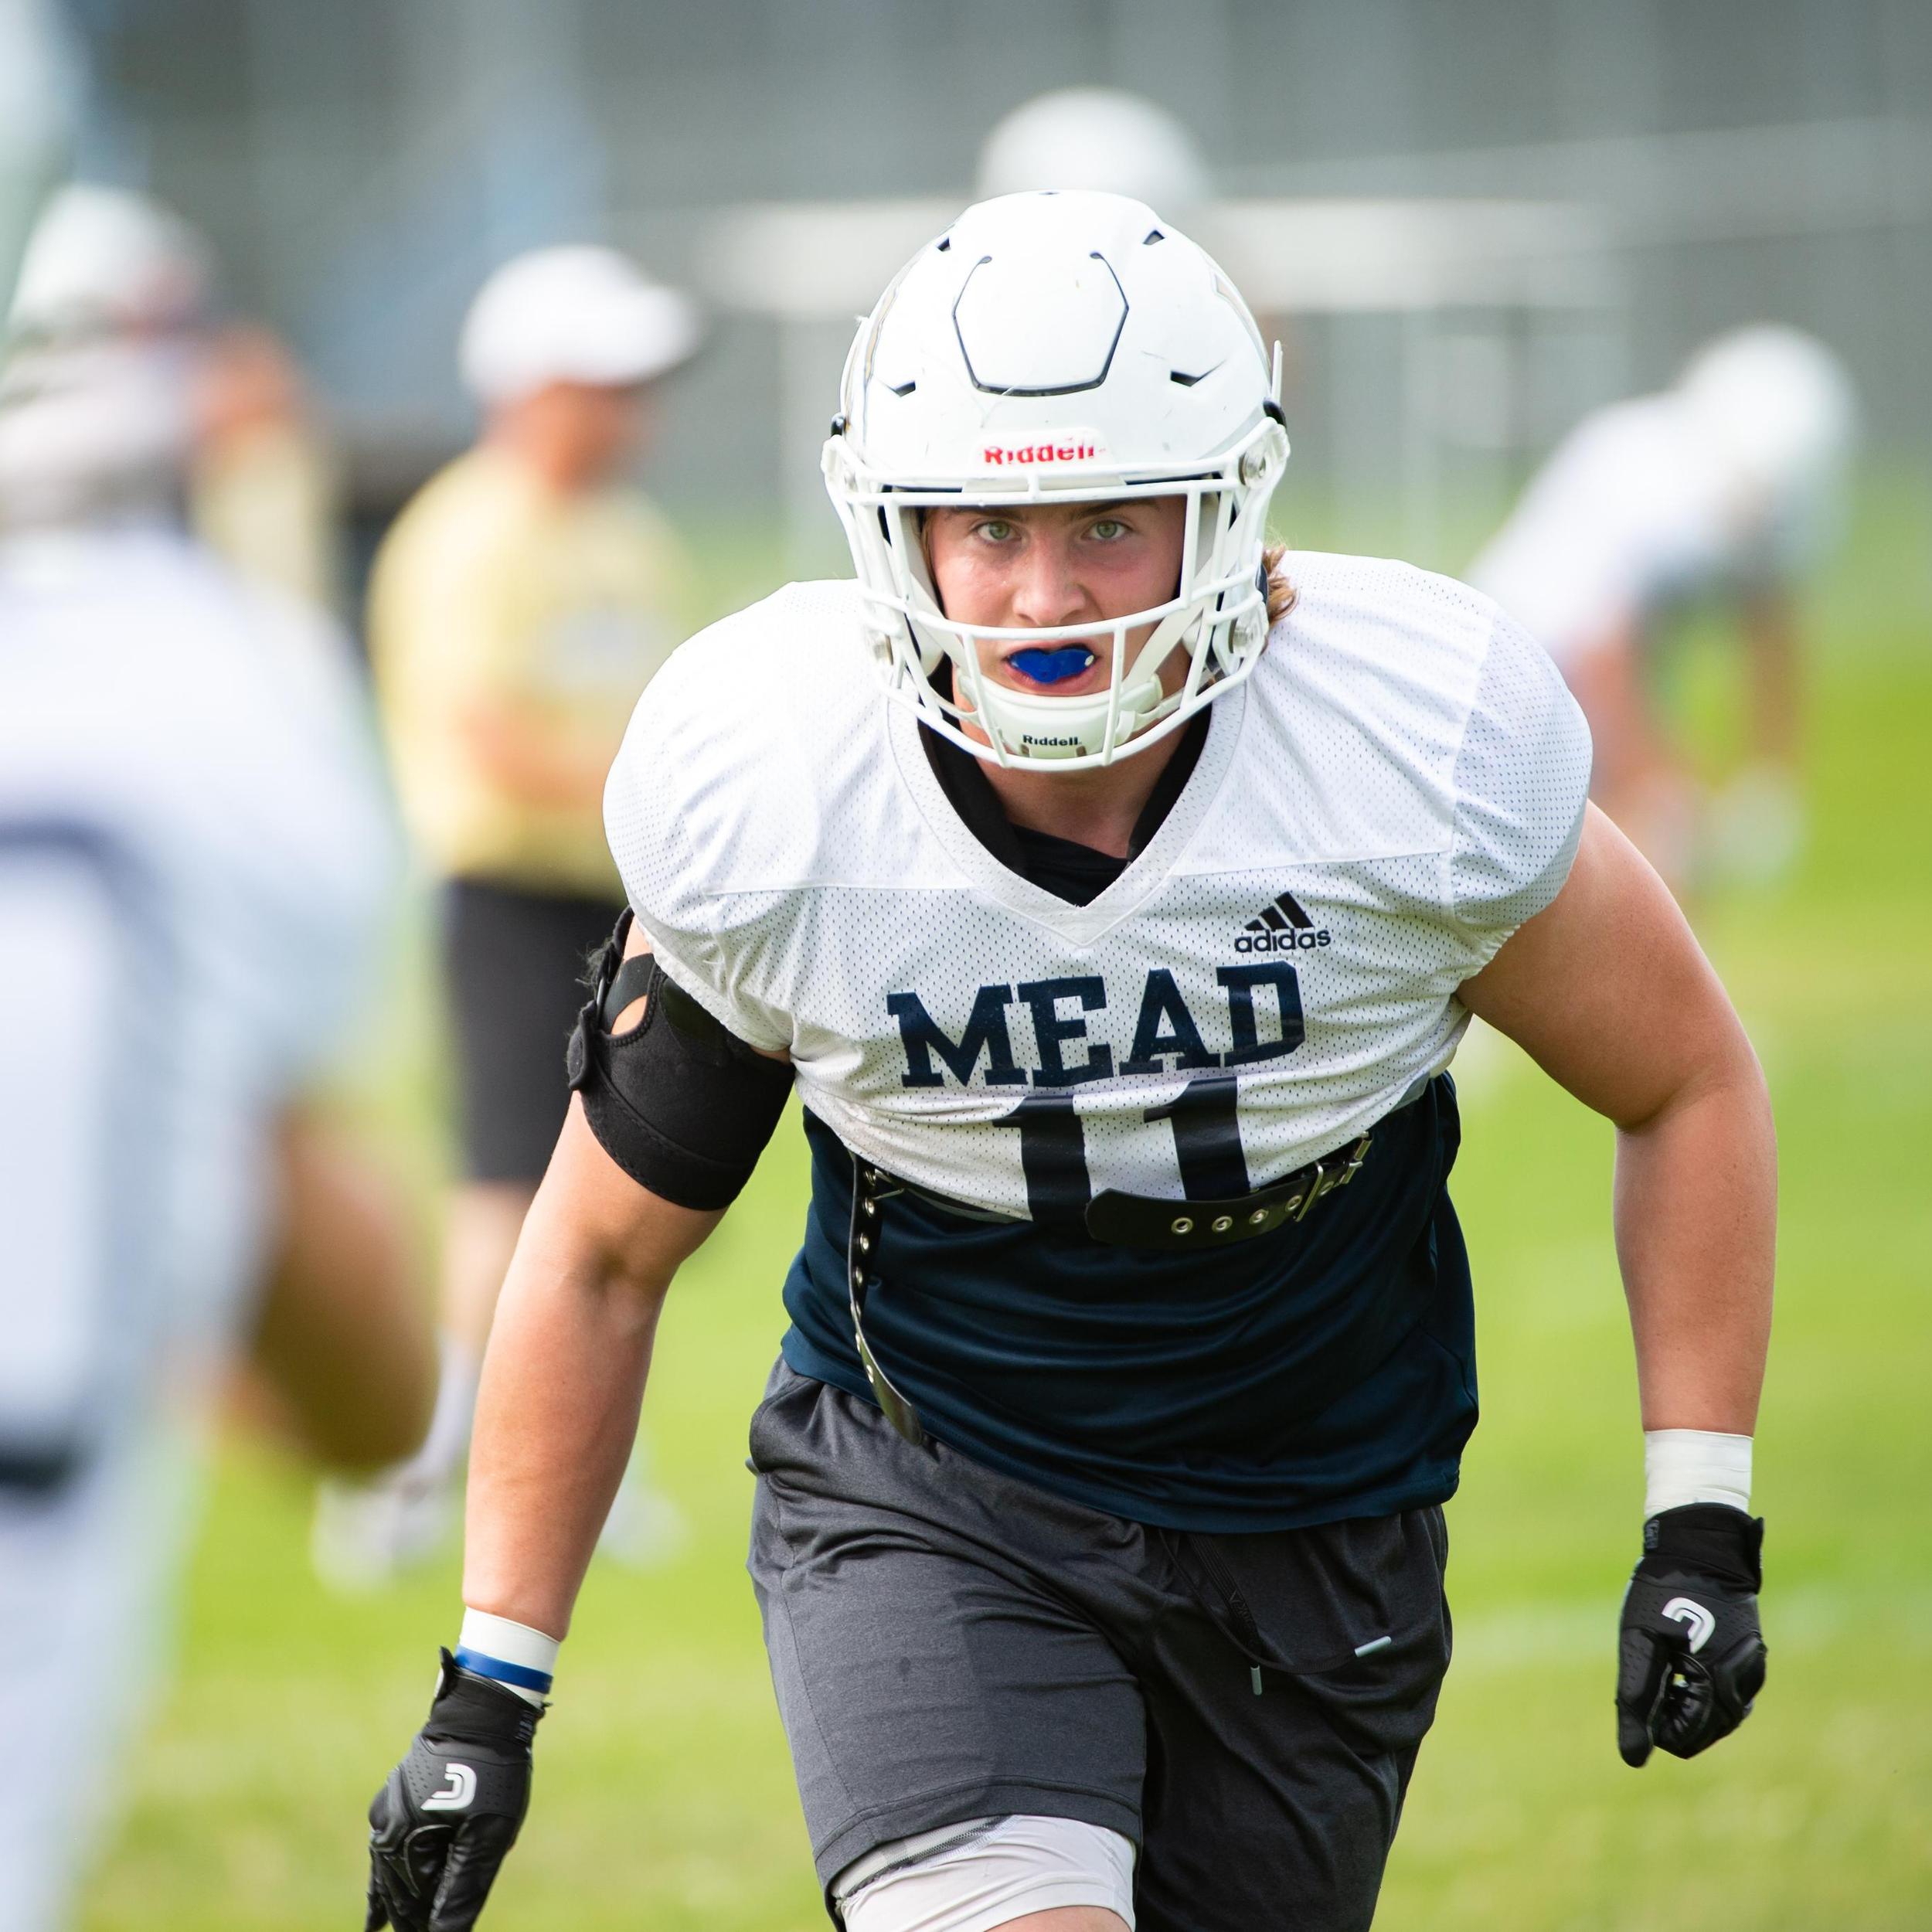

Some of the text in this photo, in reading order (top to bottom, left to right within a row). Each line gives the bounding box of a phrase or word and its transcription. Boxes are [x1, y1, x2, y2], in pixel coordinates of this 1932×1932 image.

[1022, 734, 1079, 747] Riddell
[1234, 928, 1331, 954] adidas
[887, 961, 1305, 1087] MEAD
[992, 1076, 1250, 1223] 11
